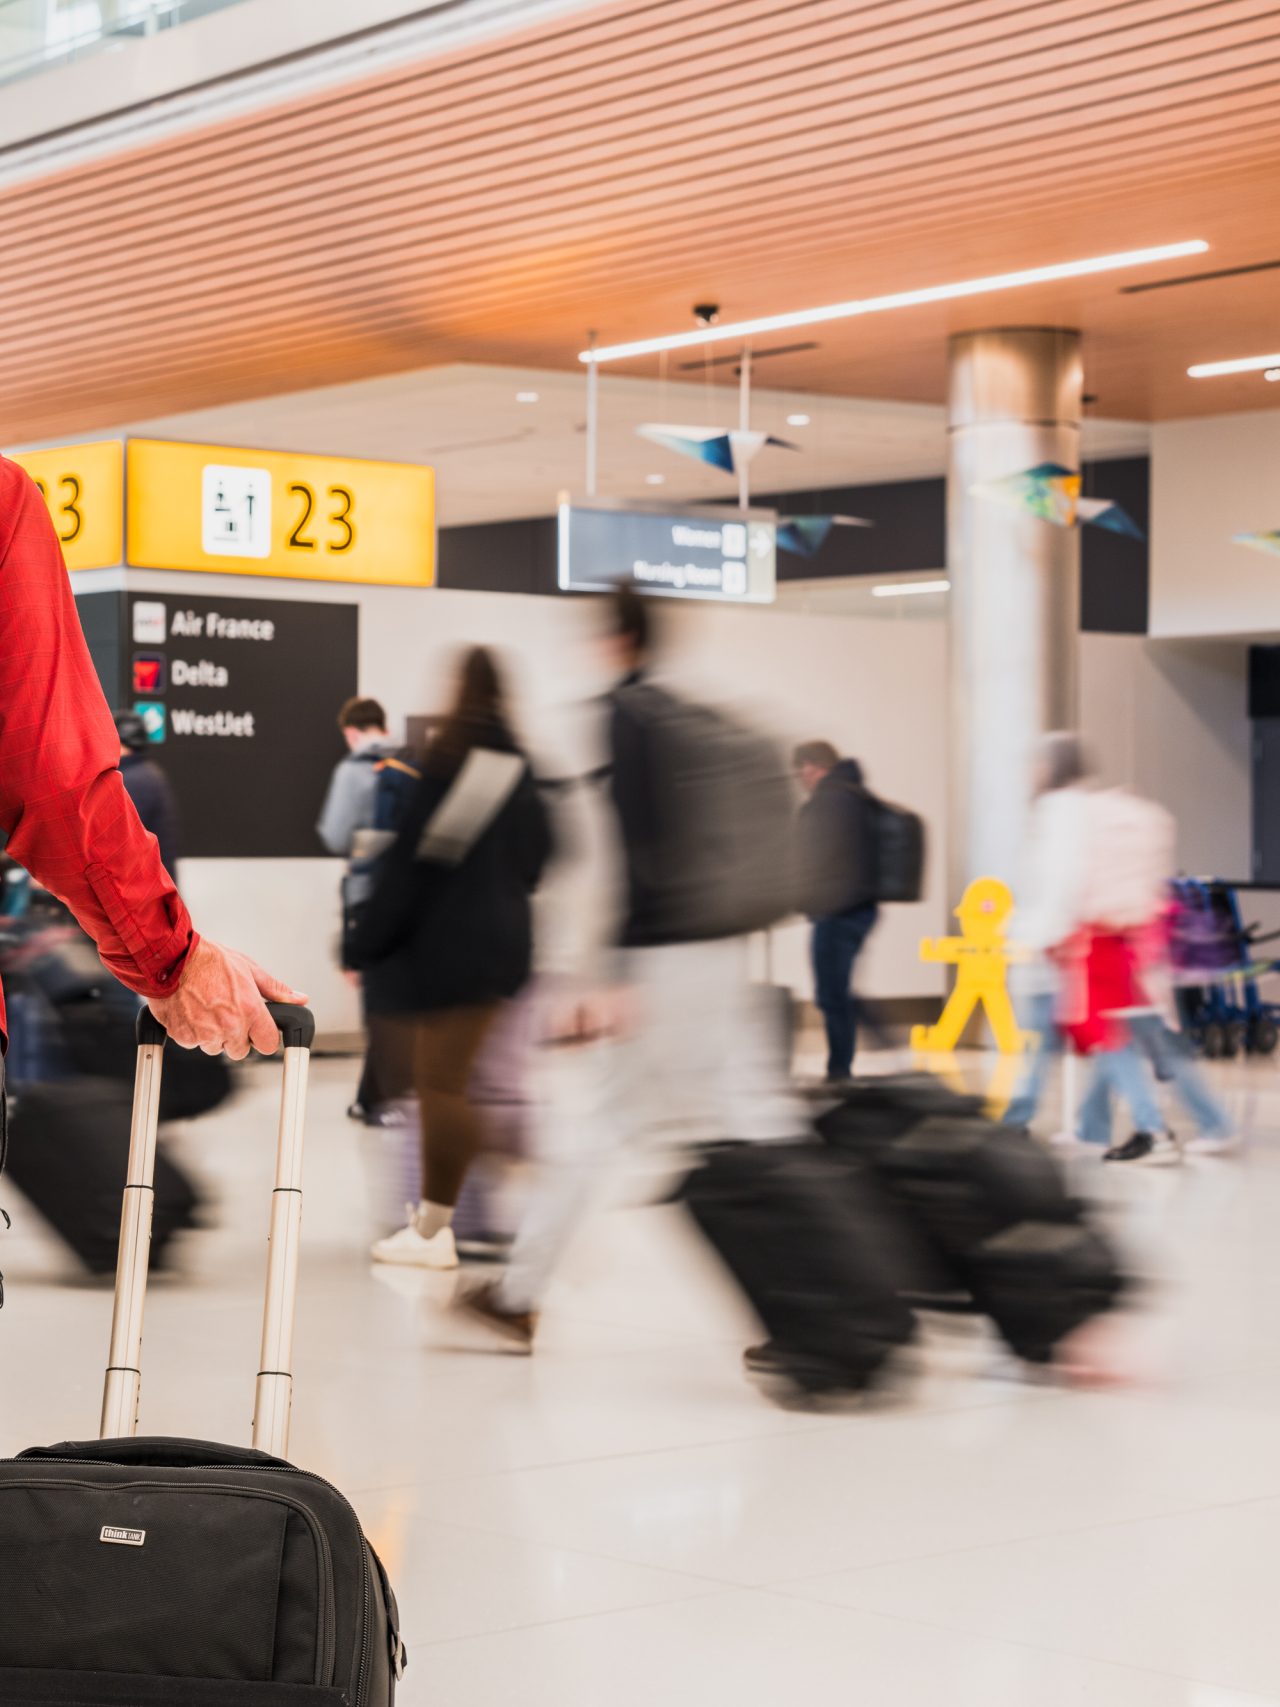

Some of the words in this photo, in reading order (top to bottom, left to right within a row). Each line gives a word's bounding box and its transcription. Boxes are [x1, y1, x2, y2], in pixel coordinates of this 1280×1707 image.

[289, 485, 353, 551] 23
[171, 610, 204, 636] Air
[206, 612, 275, 641] France
[171, 659, 229, 687] Delta
[171, 709, 255, 737] WestJet
